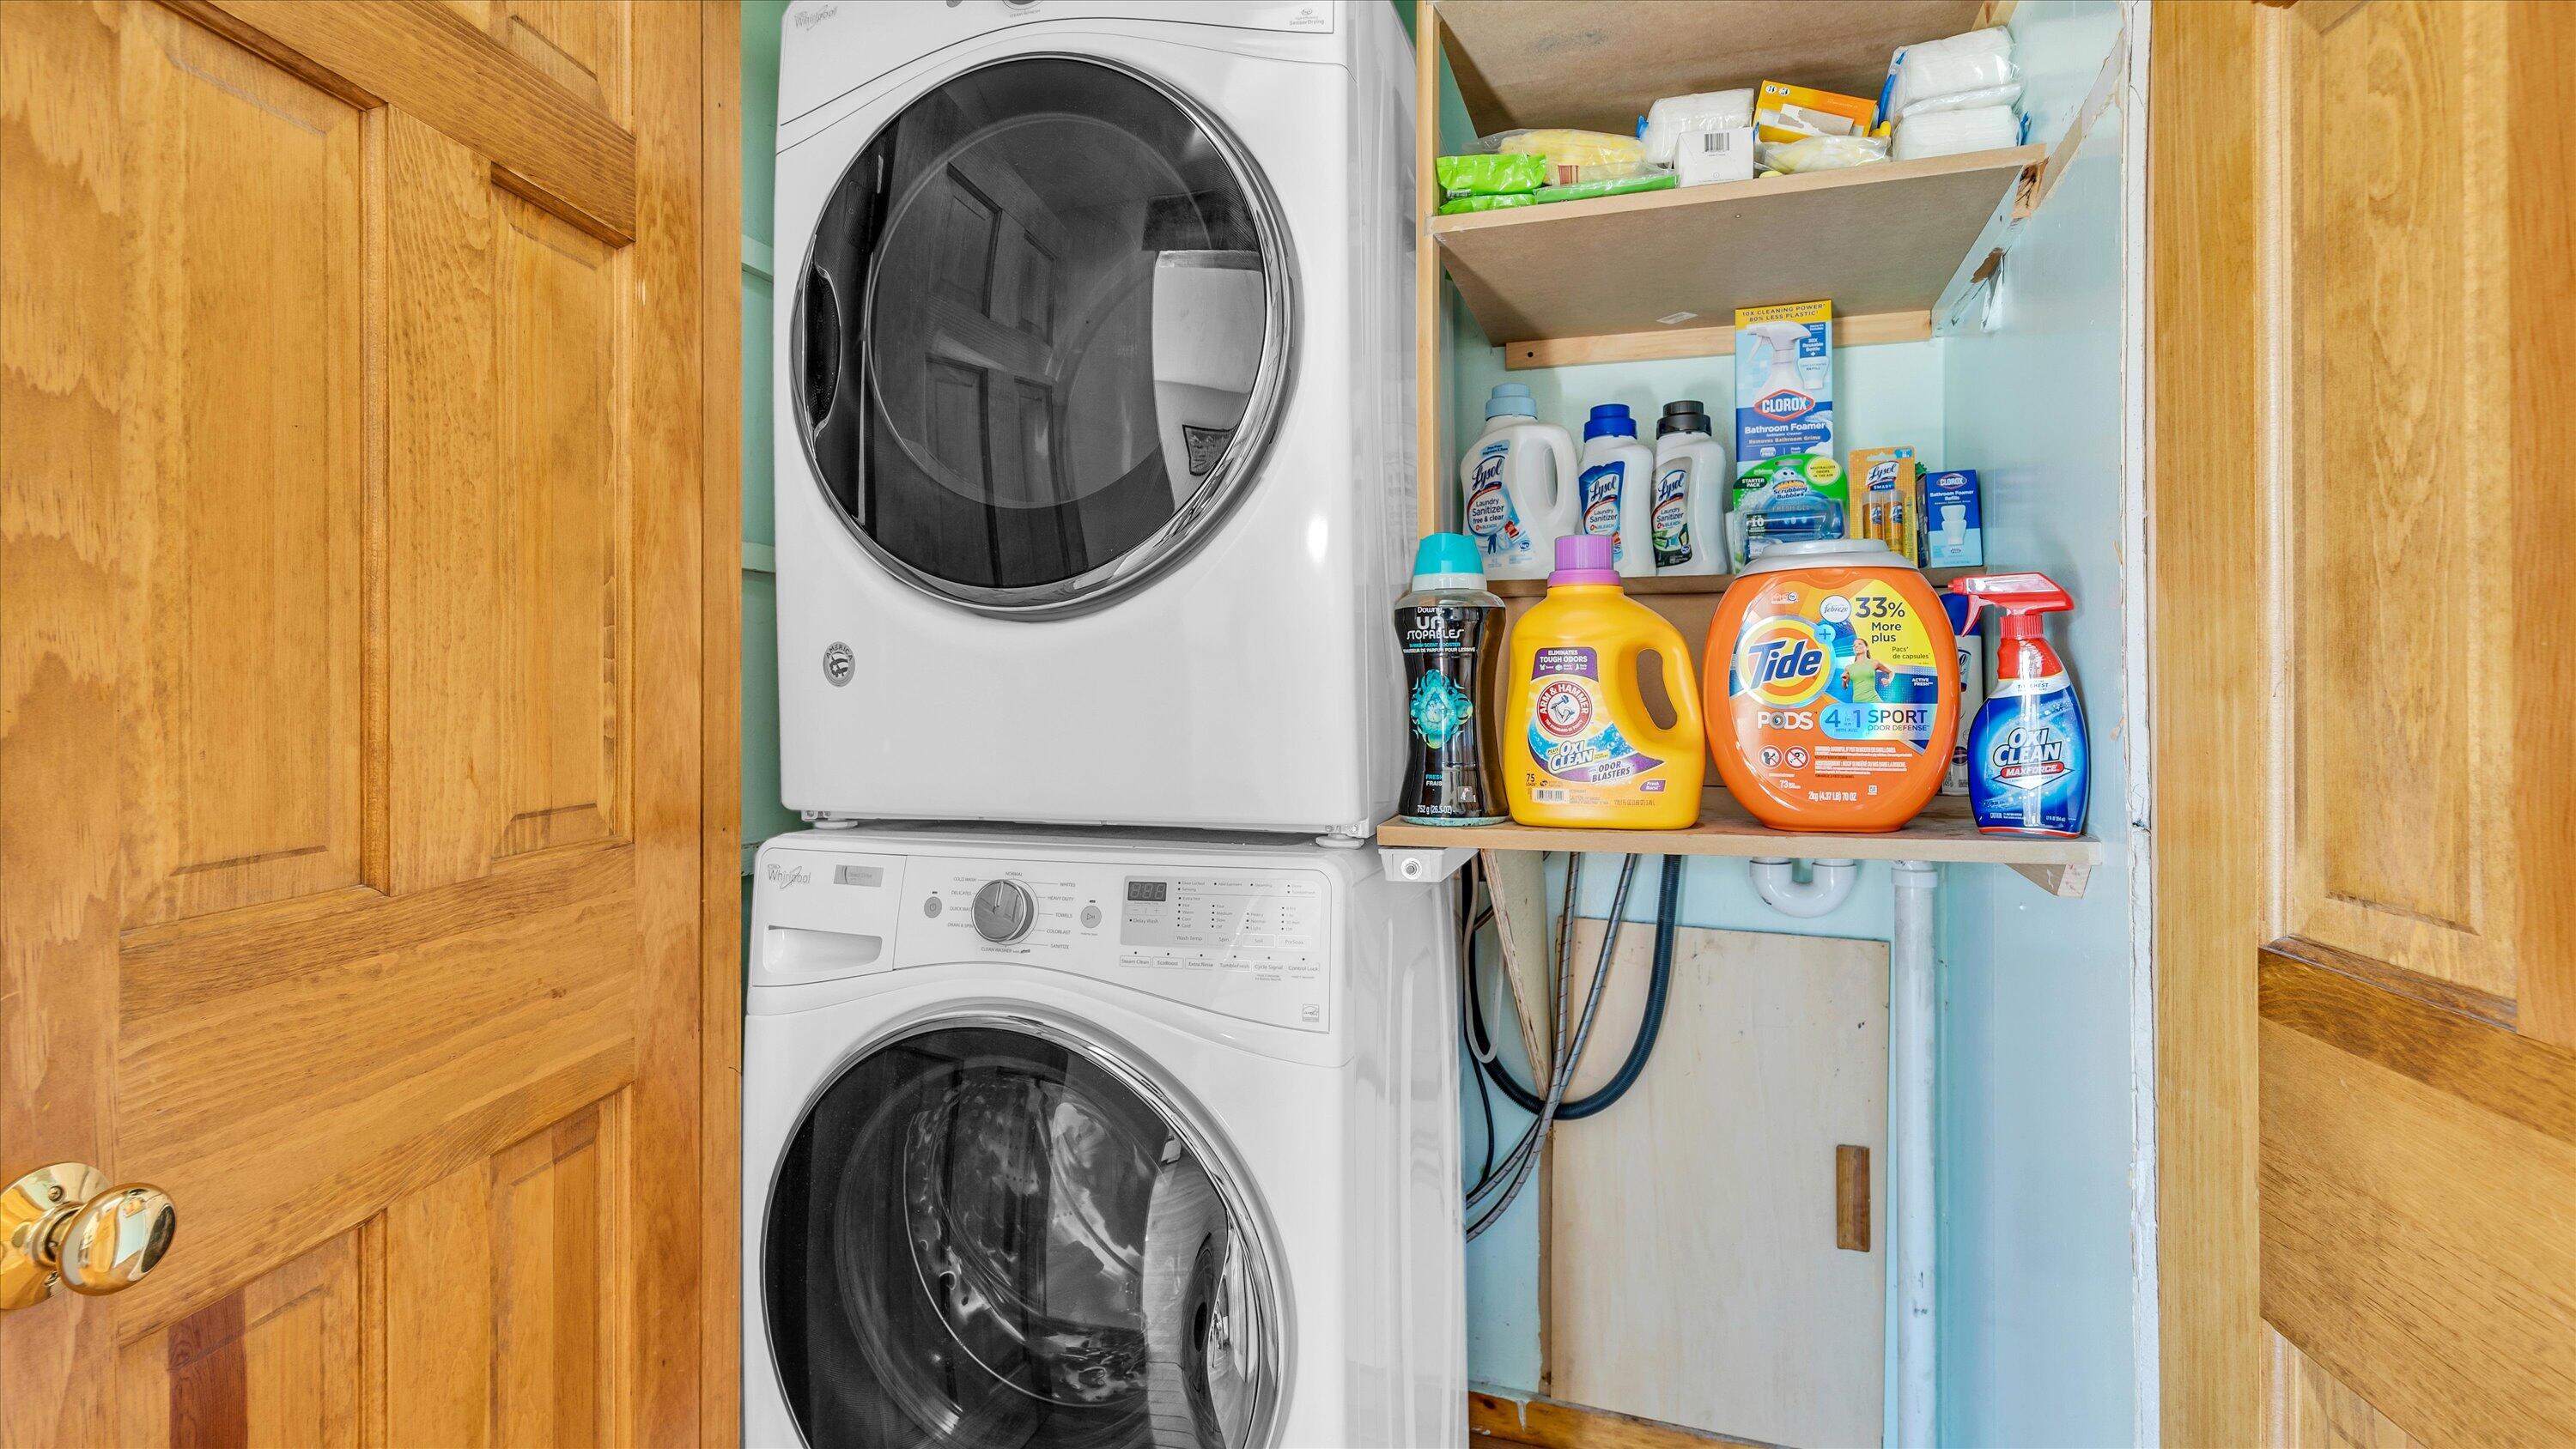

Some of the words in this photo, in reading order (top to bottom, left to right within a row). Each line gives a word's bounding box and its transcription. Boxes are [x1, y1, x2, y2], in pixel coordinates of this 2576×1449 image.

[794, 7, 838, 27] Whirlpool
[1757, 306, 1794, 315] CLEANING
[1762, 397, 1807, 413] CLOROX
[1745, 425, 1789, 434] Bathroom
[1790, 422, 1826, 431] Foamer
[1472, 458, 1503, 491] Lysol
[1868, 464, 1896, 481] Lysol
[1590, 475, 1616, 501] Lysol
[1658, 472, 1684, 501] Lysol
[1941, 477, 1964, 486] CLOROX
[1476, 498, 1499, 507] Laundry
[1472, 505, 1504, 517] Sanitizer
[1589, 514, 1618, 523] Sanitizer
[1656, 512, 1684, 522] Sanitizer
[1751, 518, 1765, 527] 10
[1855, 597, 1905, 618] 33%
[1872, 621, 1902, 632] More
[1406, 629, 1464, 640] STOPABLES
[1872, 633, 1897, 644] plus
[1748, 640, 1823, 689] Tide
[1540, 694, 1551, 714] ARM
[1550, 687, 1558, 695] &
[1558, 683, 1589, 714] HAMMER
[1757, 711, 1814, 730] PODS
[1825, 709, 1841, 728] 4
[1853, 709, 1861, 728] 1
[1868, 709, 1928, 724] SPORT
[2009, 728, 2049, 749] OXI
[1559, 741, 1584, 756] OXI
[1993, 742, 2062, 767] CLEAN
[1551, 749, 1594, 770] CLEAN
[1598, 761, 1622, 772] ODOR
[1592, 767, 1631, 783] BLASTERS
[2006, 764, 2058, 775] MAXFORCE
[1527, 773, 1535, 782] 75
[1779, 779, 1789, 788] 73
[768, 867, 811, 886] Whirlpool
